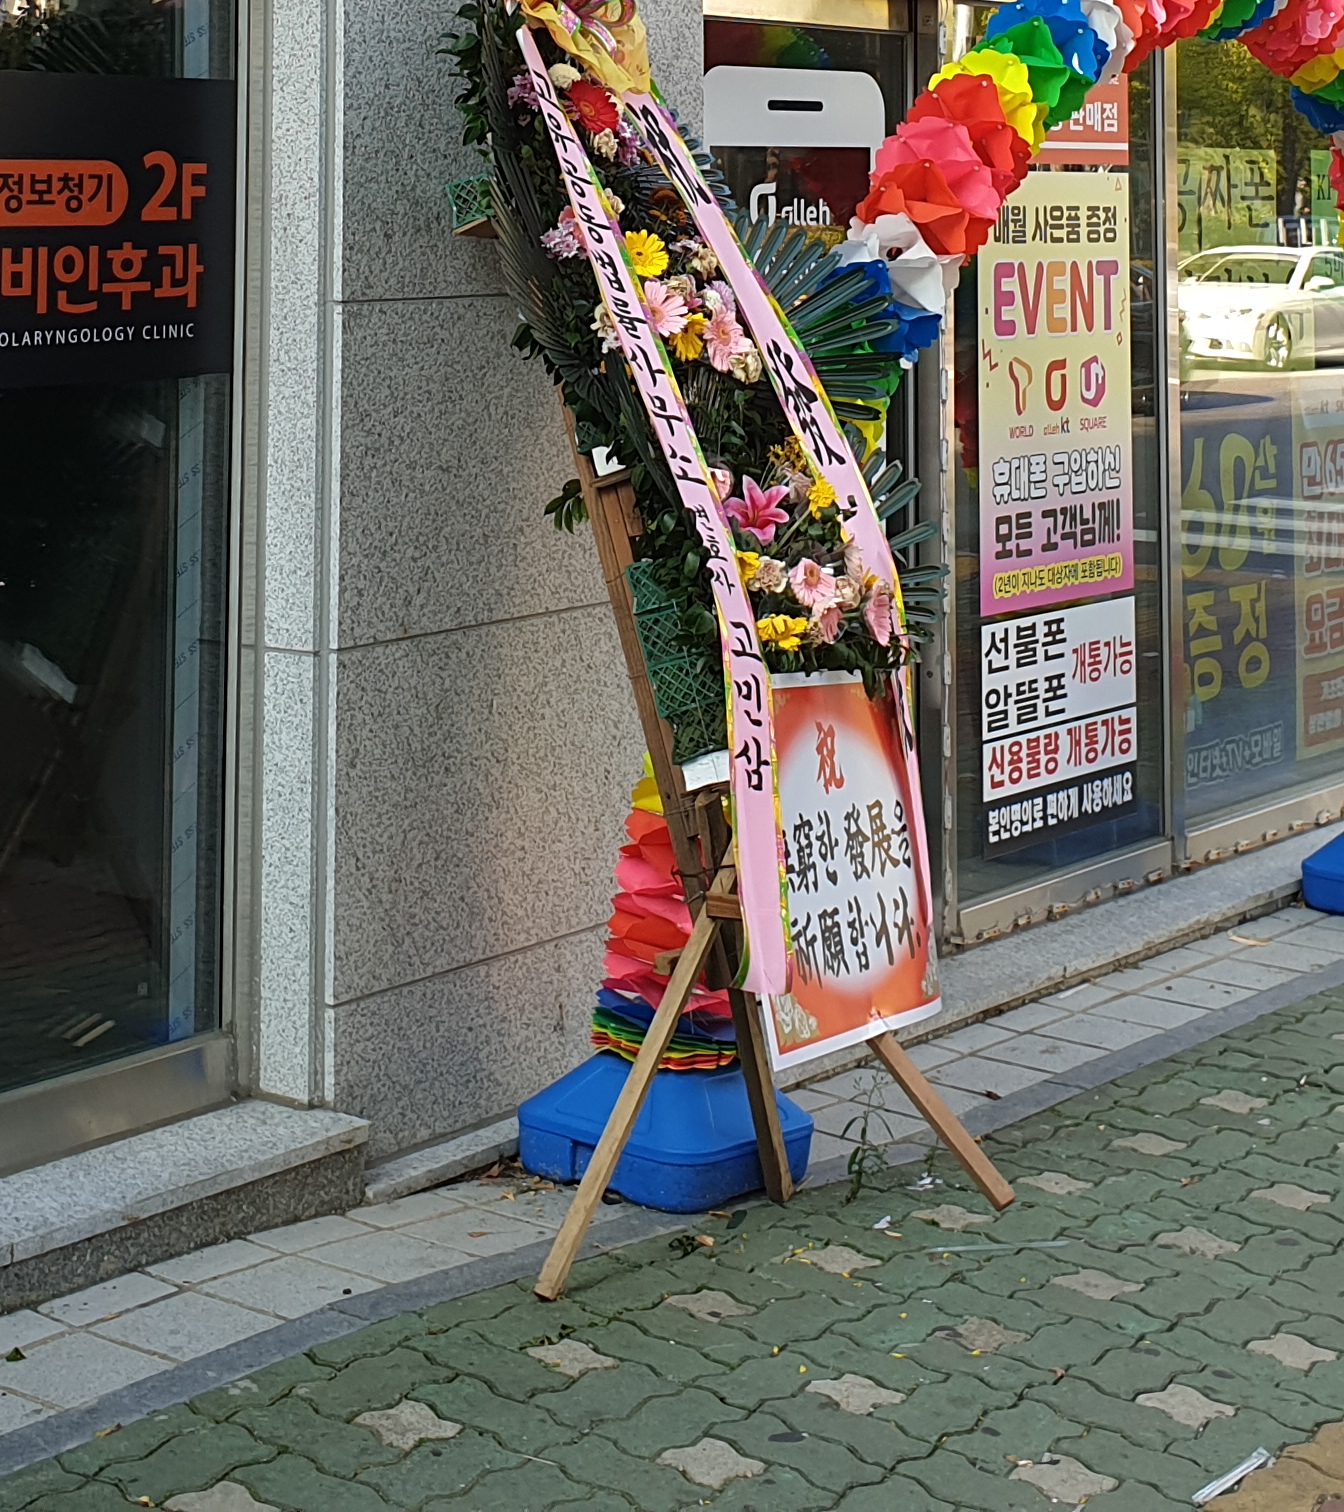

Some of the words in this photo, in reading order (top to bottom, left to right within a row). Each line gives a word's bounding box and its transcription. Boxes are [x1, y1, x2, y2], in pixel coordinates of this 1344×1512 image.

[141, 150, 208, 223] 2F
[1032, 205, 1081, 245] 사은품
[1086, 205, 1117, 244] 증정
[993, 259, 1120, 339] EVENT
[141, 322, 196, 341] CLINIC
[993, 454, 1048, 505] 휴대폰
[1053, 444, 1122, 495] 구입하신
[995, 510, 1034, 560] 모든
[1041, 498, 1122, 553] 고객님께!
[984, 617, 1068, 676] 선불폰
[1071, 635, 1134, 685] 개통가능
[1186, 579, 1271, 702] 증정
[984, 672, 1068, 734] 알뜰폰
[815, 719, 845, 795] 祝
[987, 730, 1060, 791] 신용불량
[1066, 714, 1133, 768] 개통가능
[988, 796, 1044, 844] 본인명의로
[1081, 770, 1134, 815] 사용하세요
